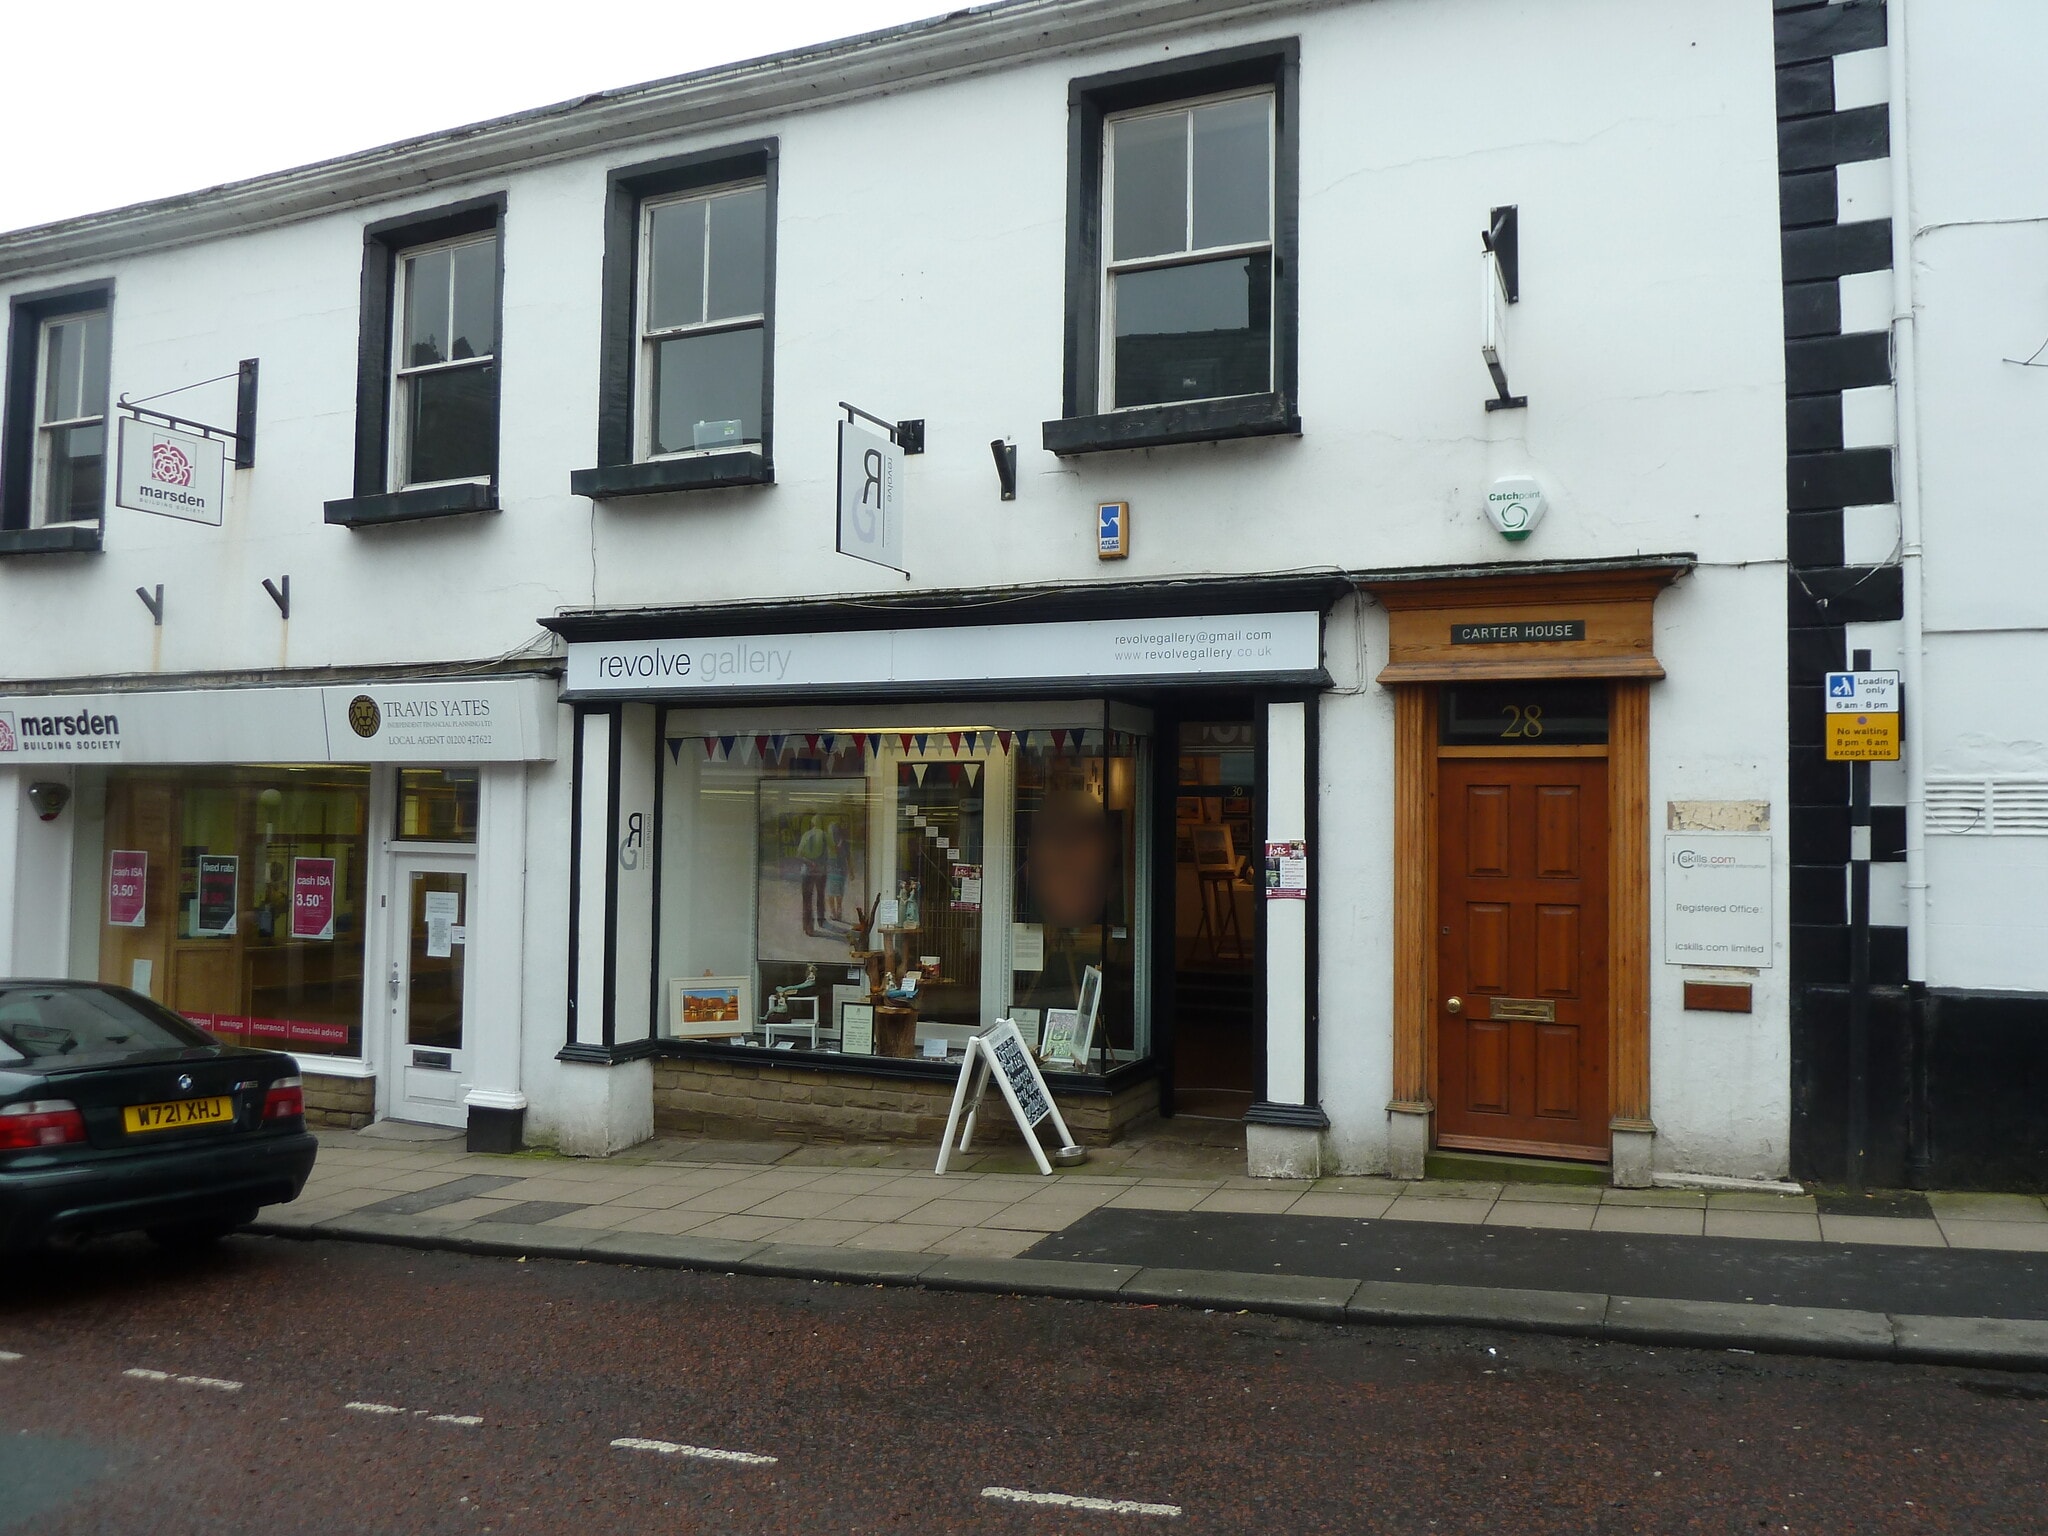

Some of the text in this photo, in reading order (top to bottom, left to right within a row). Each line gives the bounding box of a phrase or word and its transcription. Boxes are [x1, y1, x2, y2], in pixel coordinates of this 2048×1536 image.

[140, 485, 205, 508] marsden
[1489, 491, 1541, 501] Catchpoint
[139, 498, 205, 514] BUILDING SOCIETY
[1462, 624, 1573, 639] CARTER HOUSE
[599, 643, 792, 682] revolve gallery
[1857, 677, 1895, 686] Loading
[1865, 687, 1886, 695] only
[383, 699, 490, 718] TRAVIS YATES
[1836, 701, 1842, 709] 6
[20, 708, 120, 736] marsden
[452, 720, 480, 728] PLANNING
[1500, 704, 1543, 738] 28
[1854, 728, 1888, 736] waiting
[388, 736, 416, 745] LOCAL
[417, 736, 446, 745] AGENT
[446, 735, 466, 745] 01200
[1866, 738, 1873, 746] 6
[23, 740, 121, 751] BUILDING SOCIETY
[1834, 749, 1865, 757] except
[1232, 786, 1243, 797] 30
[113, 867, 143, 877] cash ISA
[220, 863, 235, 873] rate
[297, 876, 331, 886] cash ISA
[1676, 903, 1727, 913] Registered
[1675, 943, 1764, 953] icskills.com limited
[253, 1022, 285, 1032] insurance
[292, 1025, 321, 1036] financial
[321, 1027, 344, 1038] advice
[138, 1100, 222, 1126] W721 XHJ
